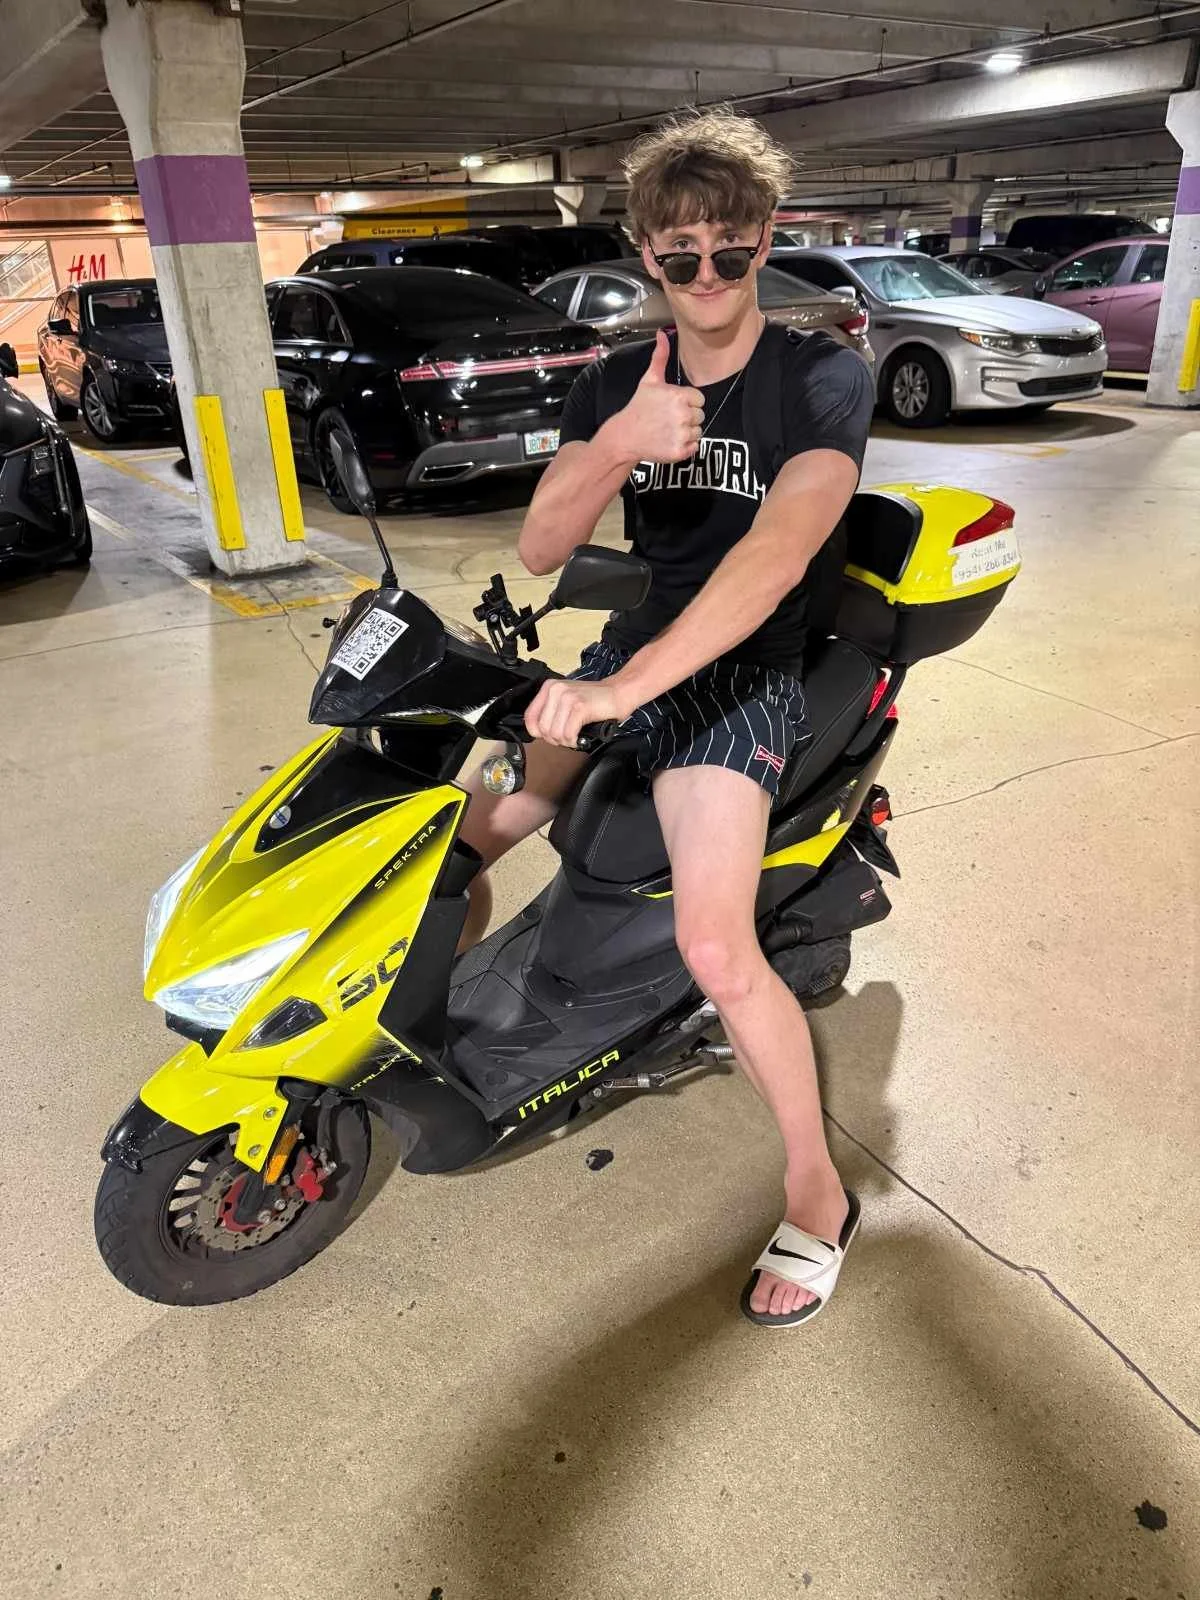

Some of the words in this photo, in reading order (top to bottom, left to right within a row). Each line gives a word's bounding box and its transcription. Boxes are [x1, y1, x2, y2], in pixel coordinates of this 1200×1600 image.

[371, 226, 417, 235] Clearance
[66, 253, 106, 284] H&M
[374, 824, 437, 890] SPEKTRA
[337, 936, 410, 1013] 50
[518, 1049, 620, 1120] ITALICA
